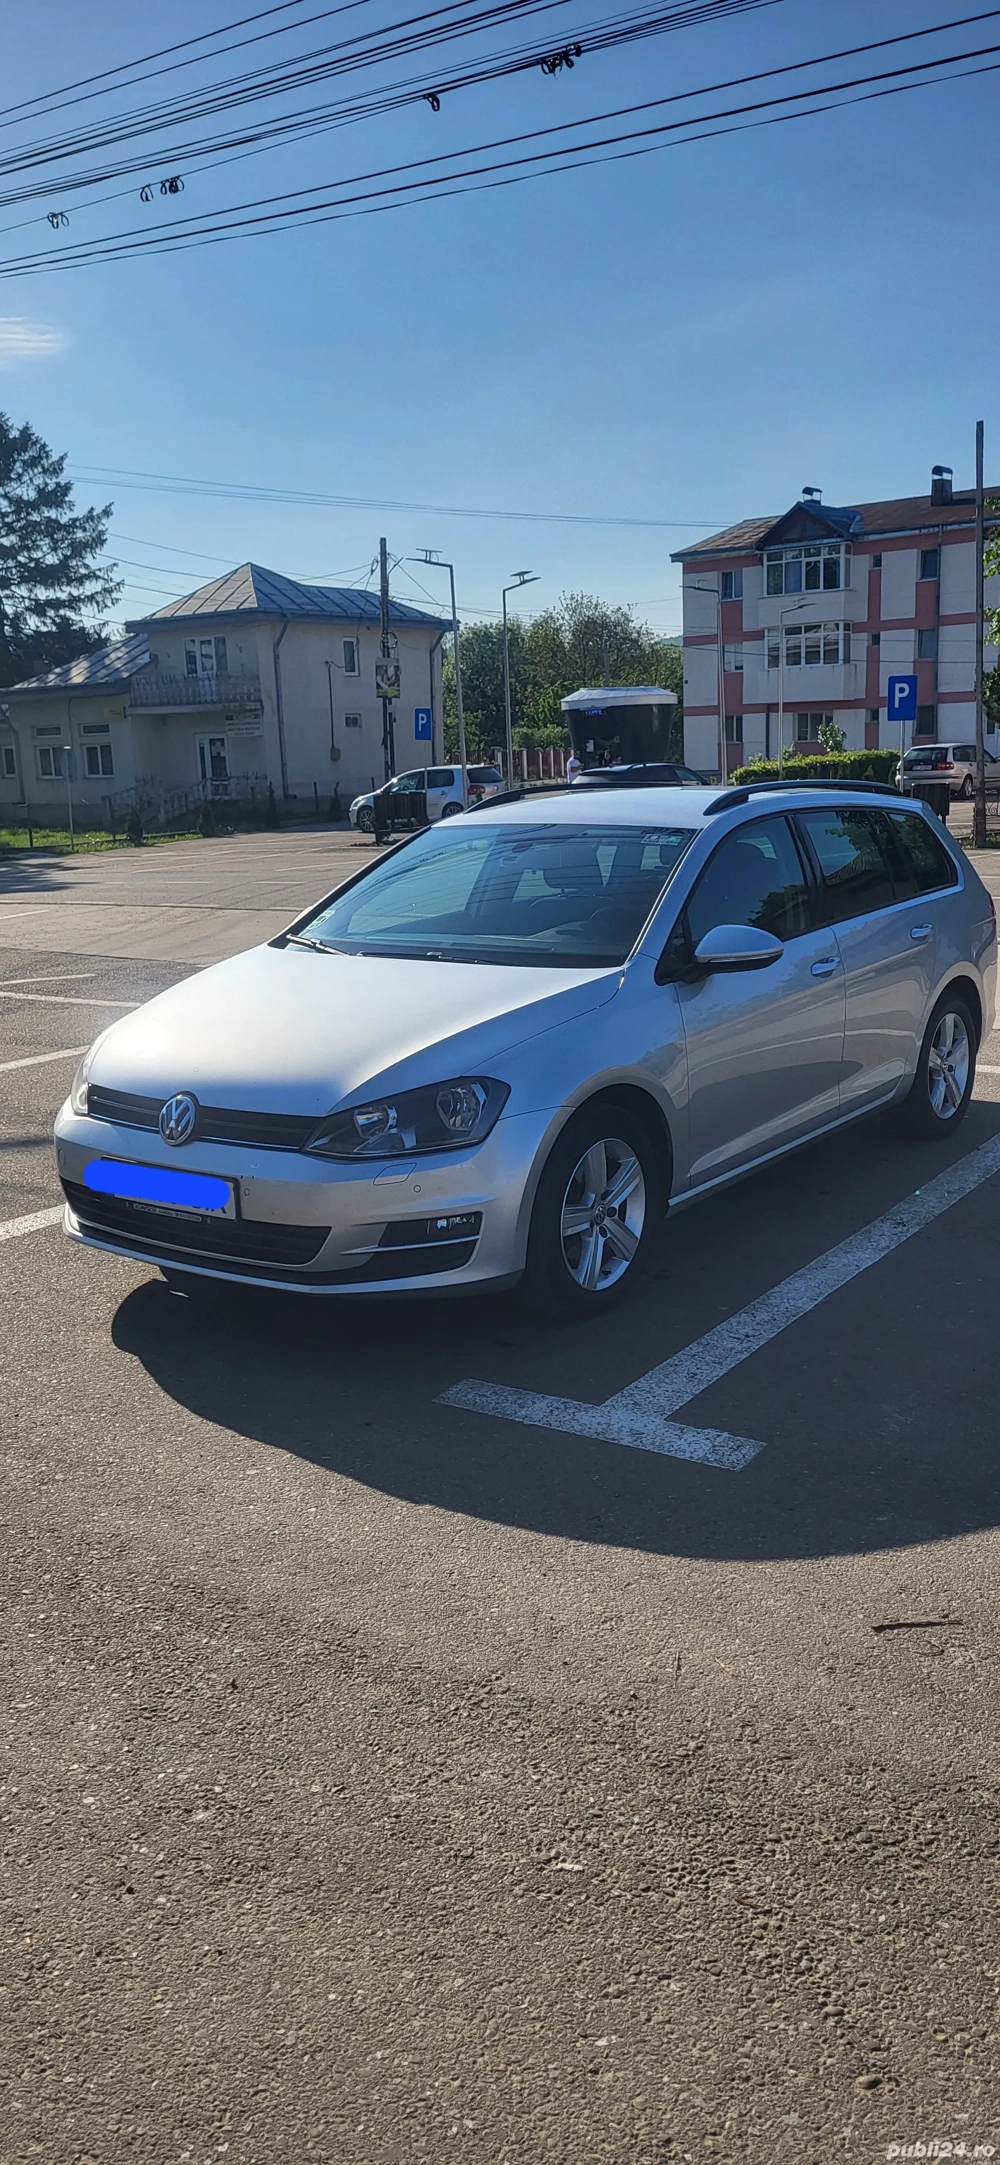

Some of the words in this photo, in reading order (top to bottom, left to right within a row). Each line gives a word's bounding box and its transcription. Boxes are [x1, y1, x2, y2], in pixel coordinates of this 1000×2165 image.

[894, 682, 910, 709] P
[418, 713, 427, 732] P
[160, 1096, 195, 1145] VW
